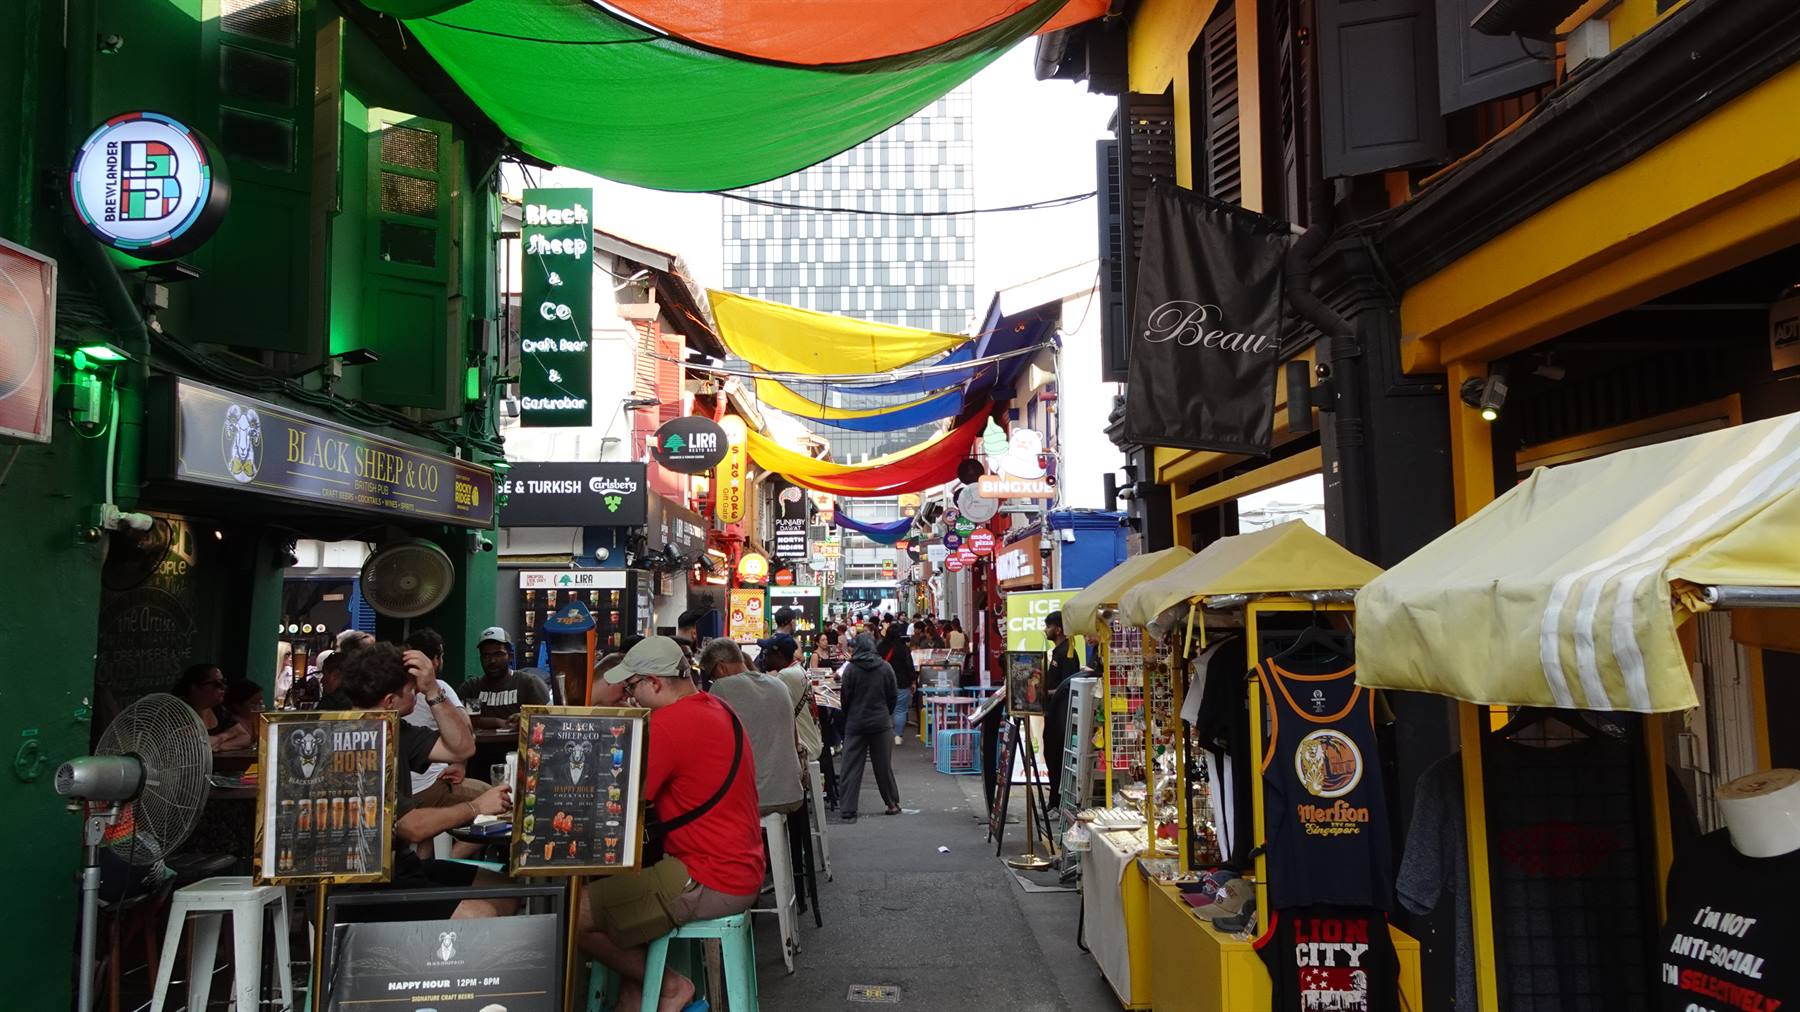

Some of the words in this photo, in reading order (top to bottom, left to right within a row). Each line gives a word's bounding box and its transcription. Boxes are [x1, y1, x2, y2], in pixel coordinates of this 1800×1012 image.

[105, 141, 118, 222] BREWLANDER
[525, 204, 588, 225] Black
[528, 235, 587, 259] Sheep
[549, 272, 563, 286] &
[522, 339, 558, 352] Craft
[559, 339, 588, 352] Beer
[548, 368, 562, 383] &
[522, 396, 587, 410] Gastrobar
[689, 433, 717, 448] LIRA
[287, 428, 350, 473] BLACK
[355, 446, 404, 485] SHEEP
[405, 461, 416, 488] &
[418, 463, 439, 493] CO
[378, 484, 389, 495] PUB
[455, 481, 472, 494] ROCKY
[515, 481, 525, 493] &
[528, 481, 581, 493] TURKISH
[589, 477, 637, 495] Carlsberg
[575, 574, 593, 584] LIRA
[1029, 600, 1060, 614] ICE
[1009, 617, 1046, 631] CRE
[479, 690, 517, 706] PUMA
[562, 722, 594, 732] BLACK
[333, 731, 379, 750] HAPPY
[332, 751, 378, 773] HOUR
[1297, 799, 1369, 823] Merlion
[1305, 823, 1360, 836] Singapore
[1693, 906, 1720, 929] I'M
[1718, 912, 1757, 938] NOT
[1294, 919, 1368, 943] LION
[1296, 943, 1368, 967] CITY
[1670, 934, 1765, 979] ANTI-SOCIAL
[388, 981, 422, 990] HAPPY
[423, 980, 450, 989] HOUR
[457, 979, 477, 987] 12PM
[483, 977, 500, 986] 8PM
[1662, 963, 1679, 985] I'M
[1680, 969, 1782, 1012] SELECTIVELY
[412, 994, 440, 1002] SIGNATURE
